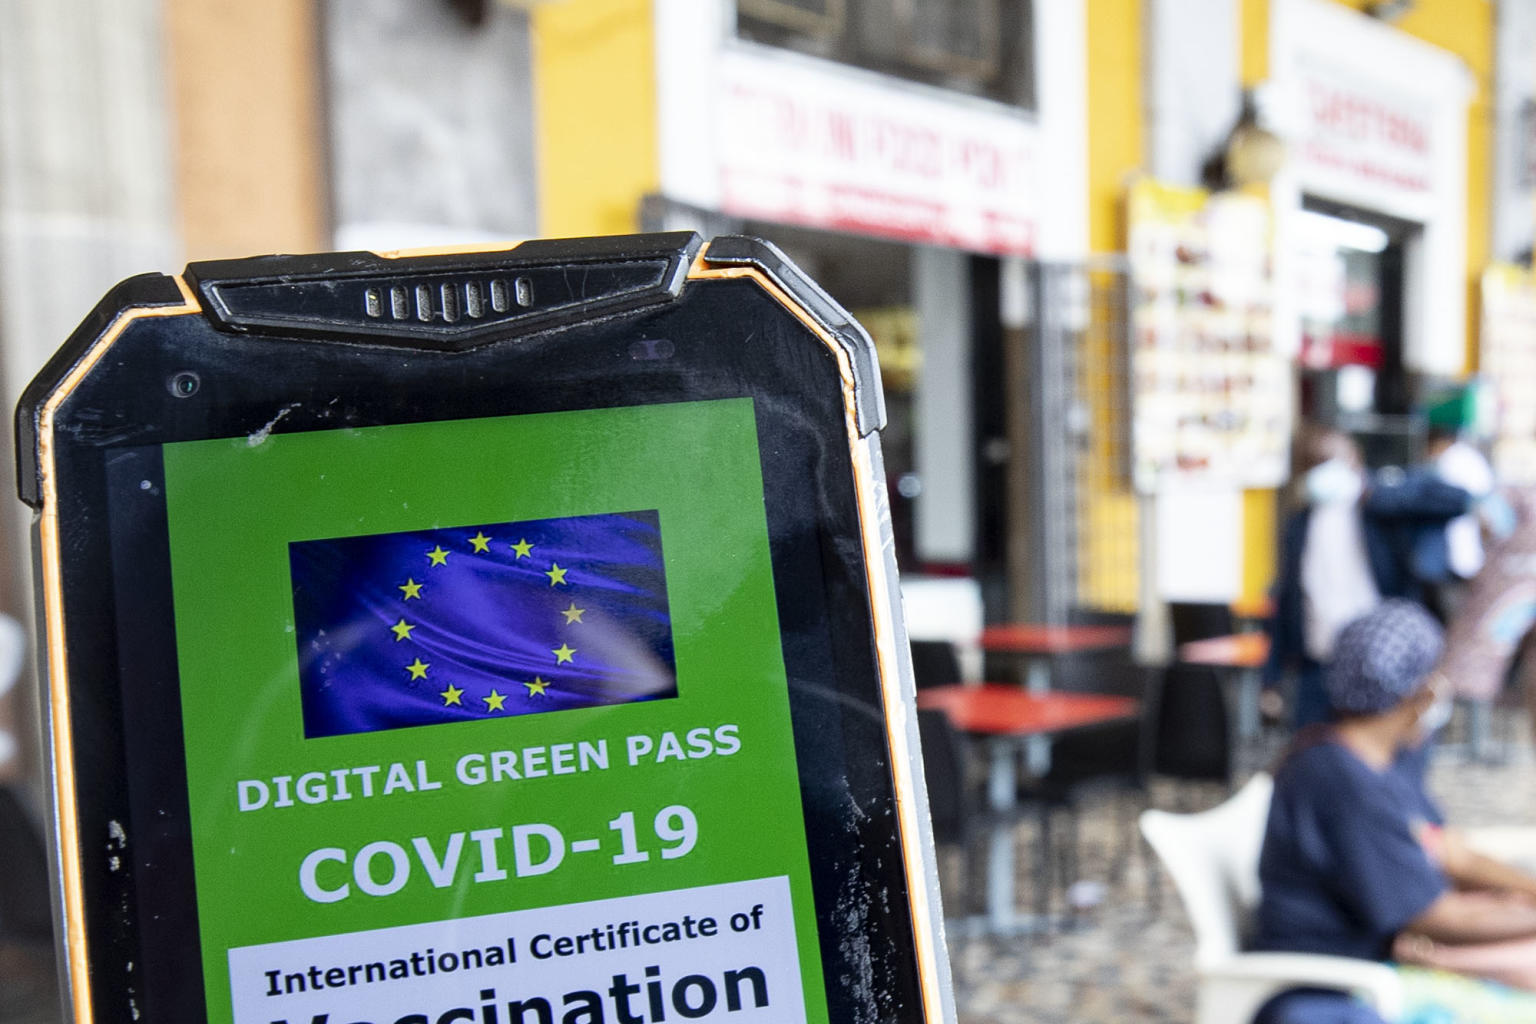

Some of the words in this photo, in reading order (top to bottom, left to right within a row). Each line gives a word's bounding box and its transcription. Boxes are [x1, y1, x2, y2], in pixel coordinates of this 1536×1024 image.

[237, 760, 442, 812] DIGITAL
[455, 740, 609, 786] GREEN
[627, 724, 742, 766] PASS
[299, 804, 699, 904] COVID-19
[265, 938, 517, 997] International
[529, 915, 718, 960] Certificate
[730, 904, 764, 933] of
